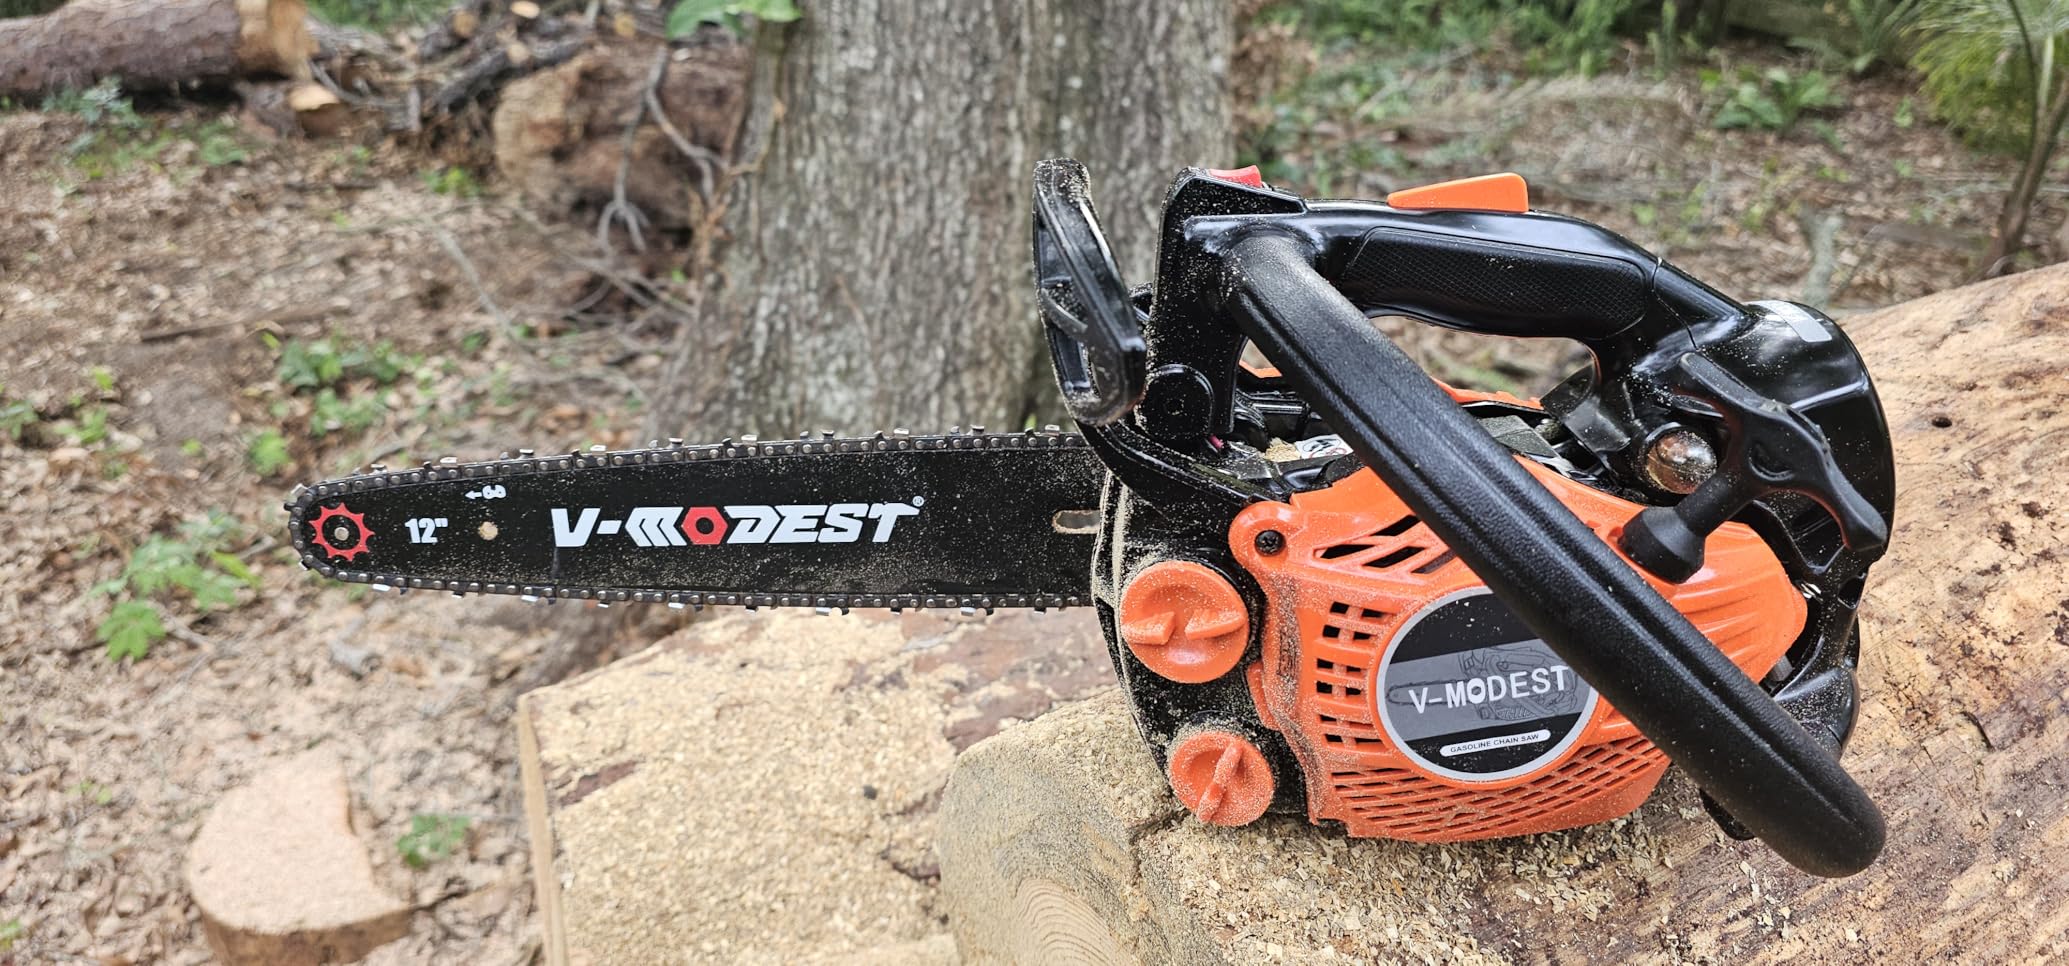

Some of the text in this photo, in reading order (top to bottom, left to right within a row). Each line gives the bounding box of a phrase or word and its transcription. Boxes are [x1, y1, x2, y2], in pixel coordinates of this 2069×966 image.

[1408, 665, 1569, 714] V-MODEST
[1450, 733, 1540, 753] GASOLINE CHAIN SAW
